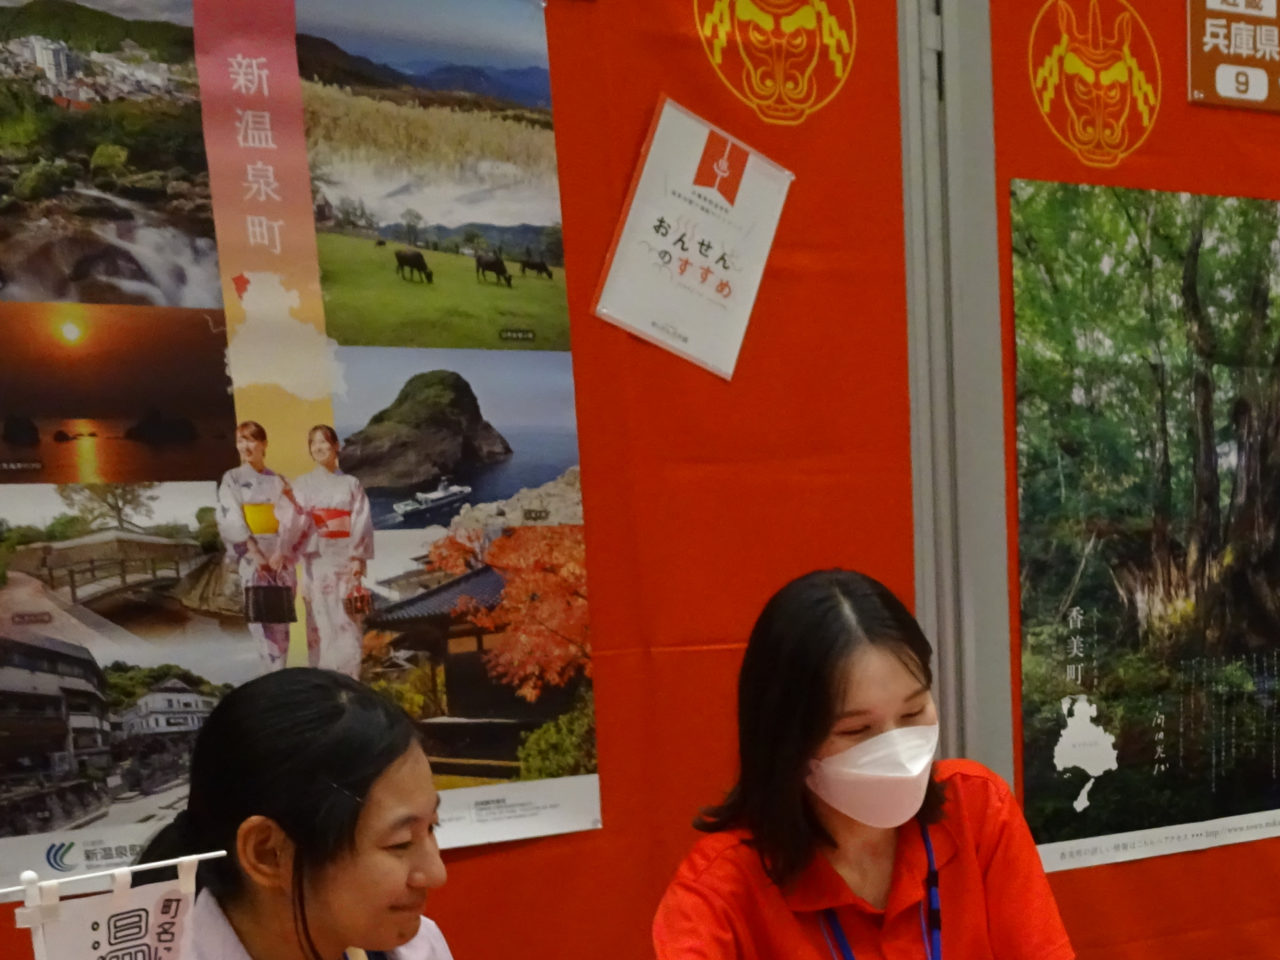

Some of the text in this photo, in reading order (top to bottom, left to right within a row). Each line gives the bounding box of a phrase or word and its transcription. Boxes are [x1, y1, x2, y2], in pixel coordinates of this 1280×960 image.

[1203, 17, 1280, 60] 兵庫県
[1234, 70, 1250, 94] 9
[228, 52, 285, 256] 新温泉町
[652, 215, 732, 271] おんせん
[657, 247, 733, 299] のすすめ
[1066, 606, 1085, 686] 香美町
